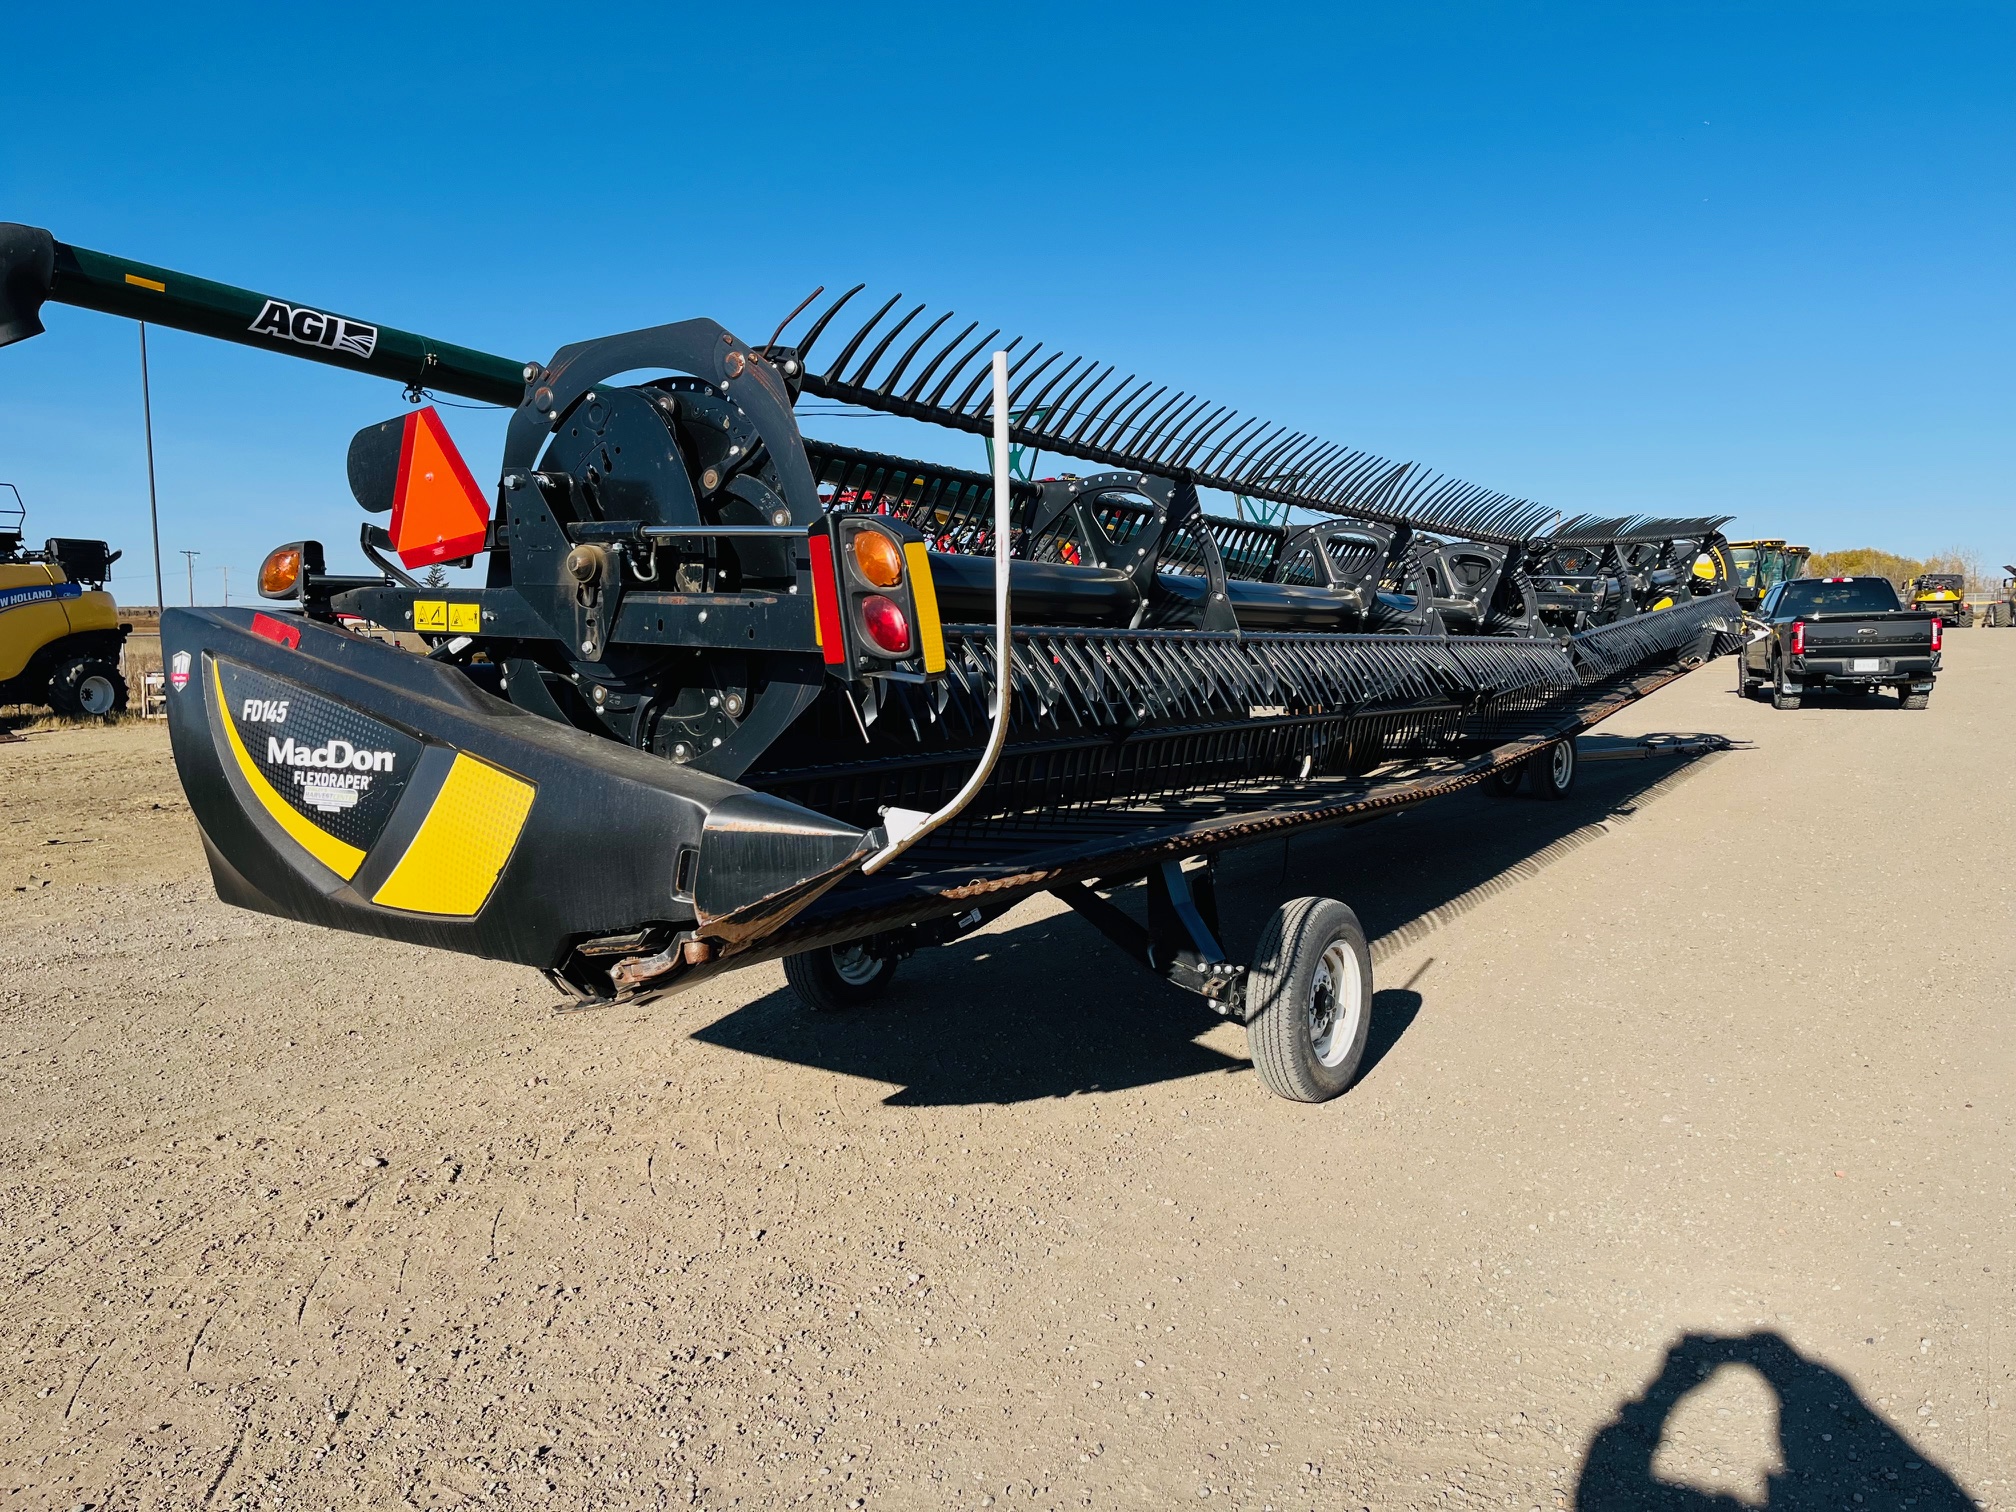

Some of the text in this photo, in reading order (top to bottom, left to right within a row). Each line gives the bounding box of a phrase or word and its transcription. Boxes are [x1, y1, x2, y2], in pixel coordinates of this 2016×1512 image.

[247, 299, 339, 351] AGI
[10, 589, 53, 603] HOLLAND
[242, 698, 289, 723] FD145
[267, 736, 394, 772] MacDon
[293, 770, 370, 790] FLEXDRAPER
